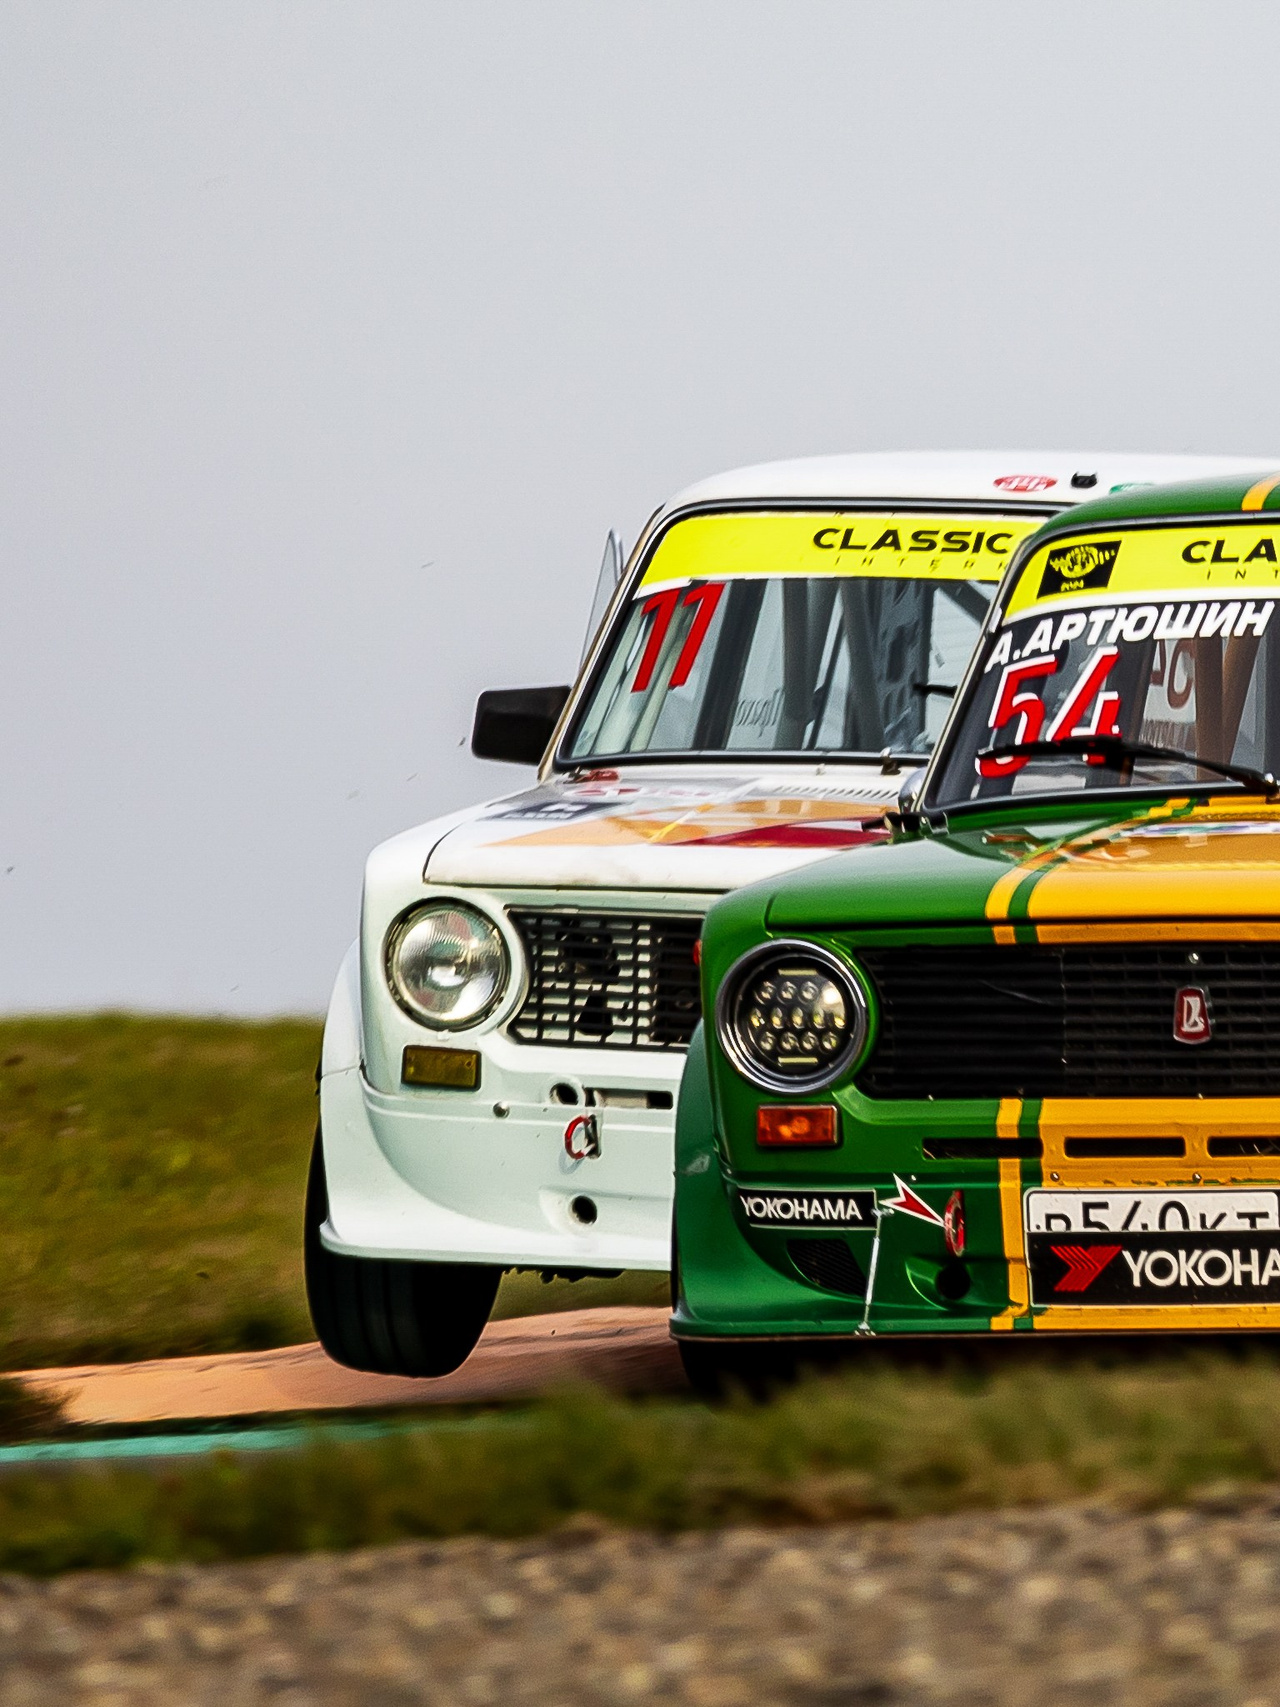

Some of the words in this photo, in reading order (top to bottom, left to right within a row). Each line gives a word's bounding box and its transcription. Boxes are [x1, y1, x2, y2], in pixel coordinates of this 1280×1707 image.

[813, 527, 1014, 554] CLASSIC
[630, 583, 726, 692] 11
[984, 600, 1275, 673] А.АРТЮШИН
[974, 645, 1123, 778] 54
[740, 1195, 863, 1221] YOKOHAMA
